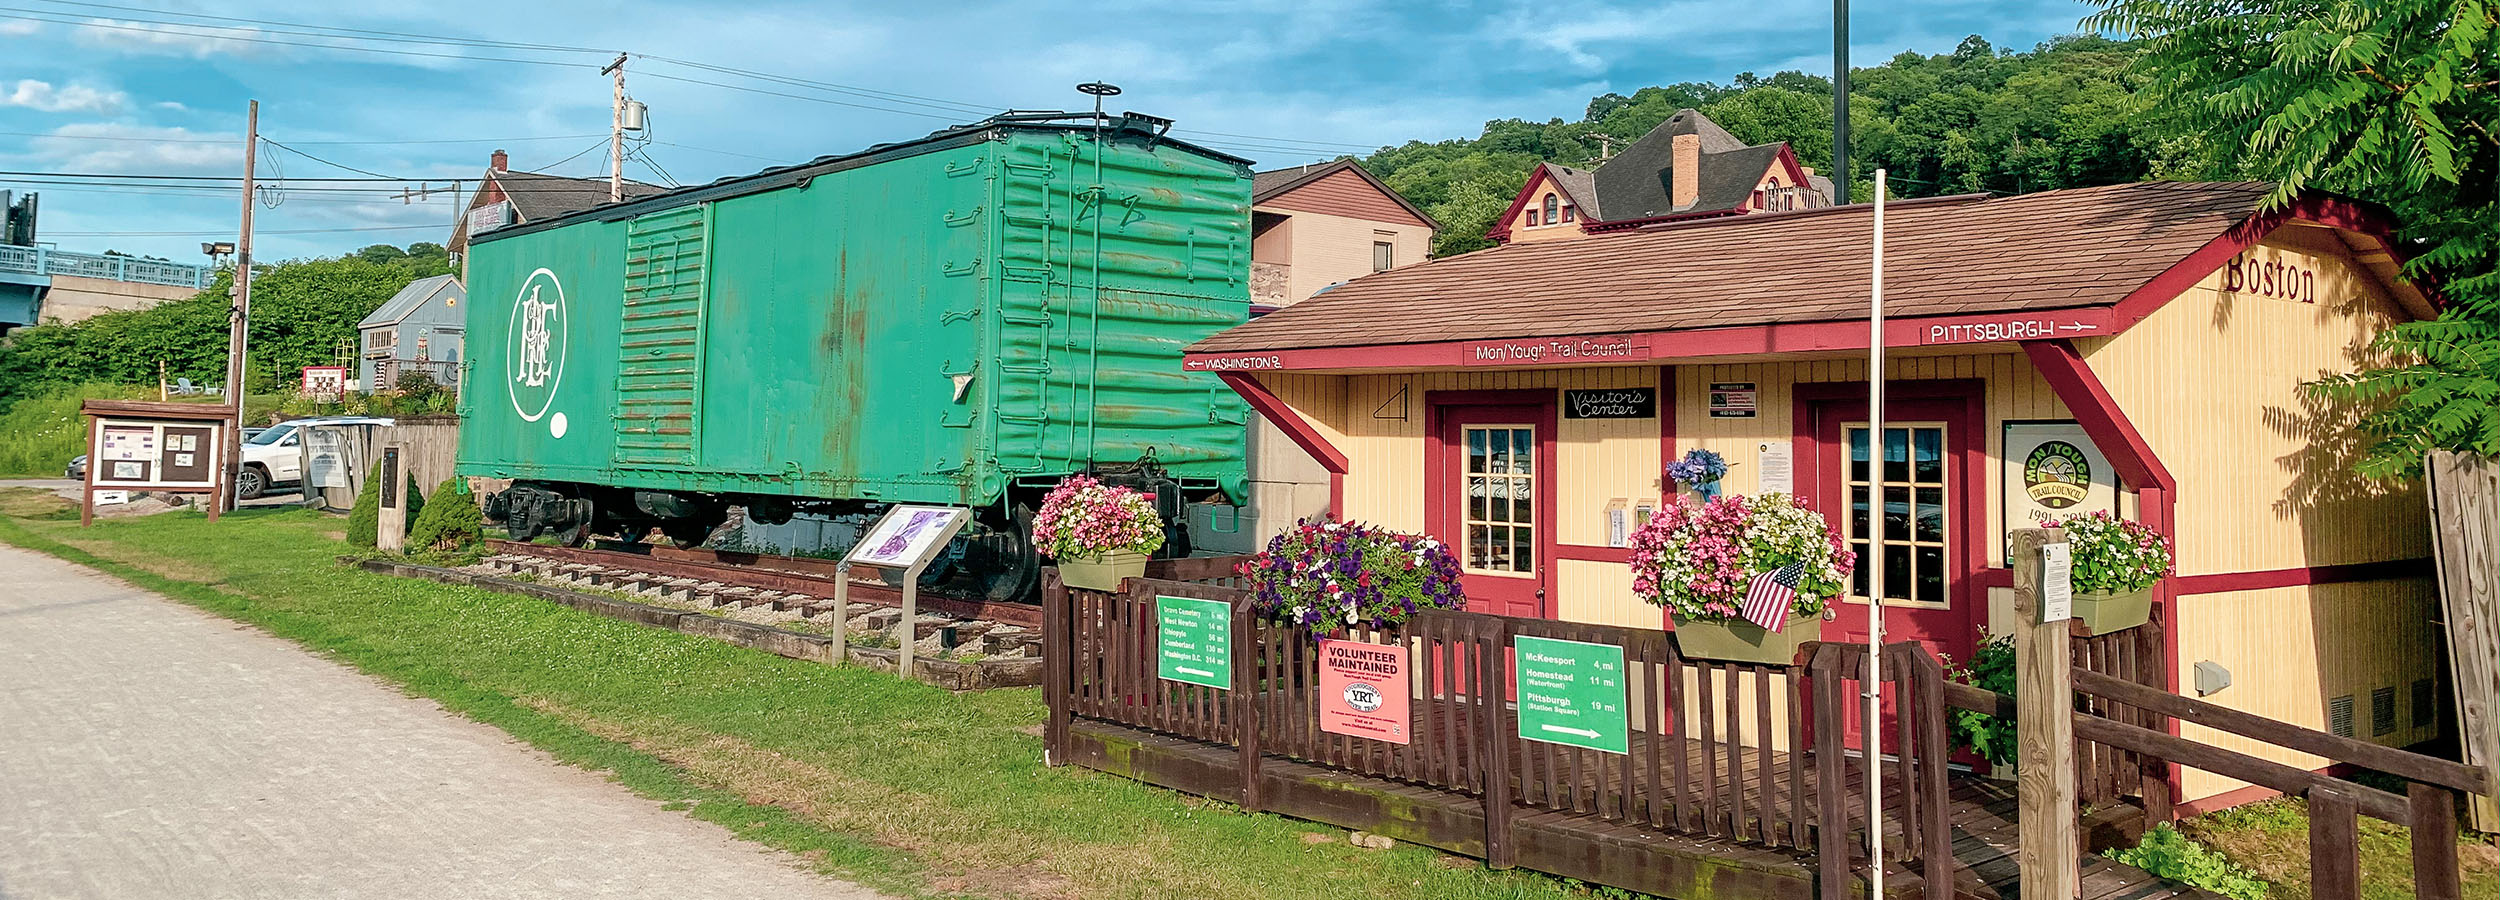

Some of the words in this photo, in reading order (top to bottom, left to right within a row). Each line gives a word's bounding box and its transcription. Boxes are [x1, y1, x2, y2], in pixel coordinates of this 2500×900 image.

[2226, 251, 2315, 304] Boston
[1930, 321, 2054, 343] PITTSBURGH
[1476, 342, 1546, 361] Mon/Yough
[1550, 341, 1577, 357] Trail
[1581, 339, 1632, 357] Council
[1205, 357, 1270, 370] WASHINGTON
[1570, 390, 1647, 411] Visitor's
[1578, 403, 1637, 418] Center
[2026, 443, 2088, 485] MON/YOUGH
[2032, 488, 2052, 498] TRAIL
[2052, 485, 2081, 499] COUNCIL
[1164, 639, 1195, 649] Cumberland
[1216, 646, 1225, 654] mi
[1216, 635, 1224, 643] mi
[1164, 650, 1192, 661] Washington
[1205, 656, 1216, 664] 314
[1329, 646, 1397, 664] VOLUNTEER
[1525, 652, 1576, 666] McKeesport
[1602, 662, 1614, 671] mi
[1328, 657, 1398, 674] MAINTAINED
[1526, 668, 1574, 682] Homestead
[1589, 676, 1600, 685] 11
[1603, 678, 1614, 687] mi
[1526, 678, 1566, 690] (Waterfront)
[1352, 690, 1374, 703] YRT
[1527, 692, 1571, 707] Pittsburgh
[1591, 701, 1601, 710] 19
[1604, 703, 1616, 712] mi
[1554, 705, 1580, 717] Square)
